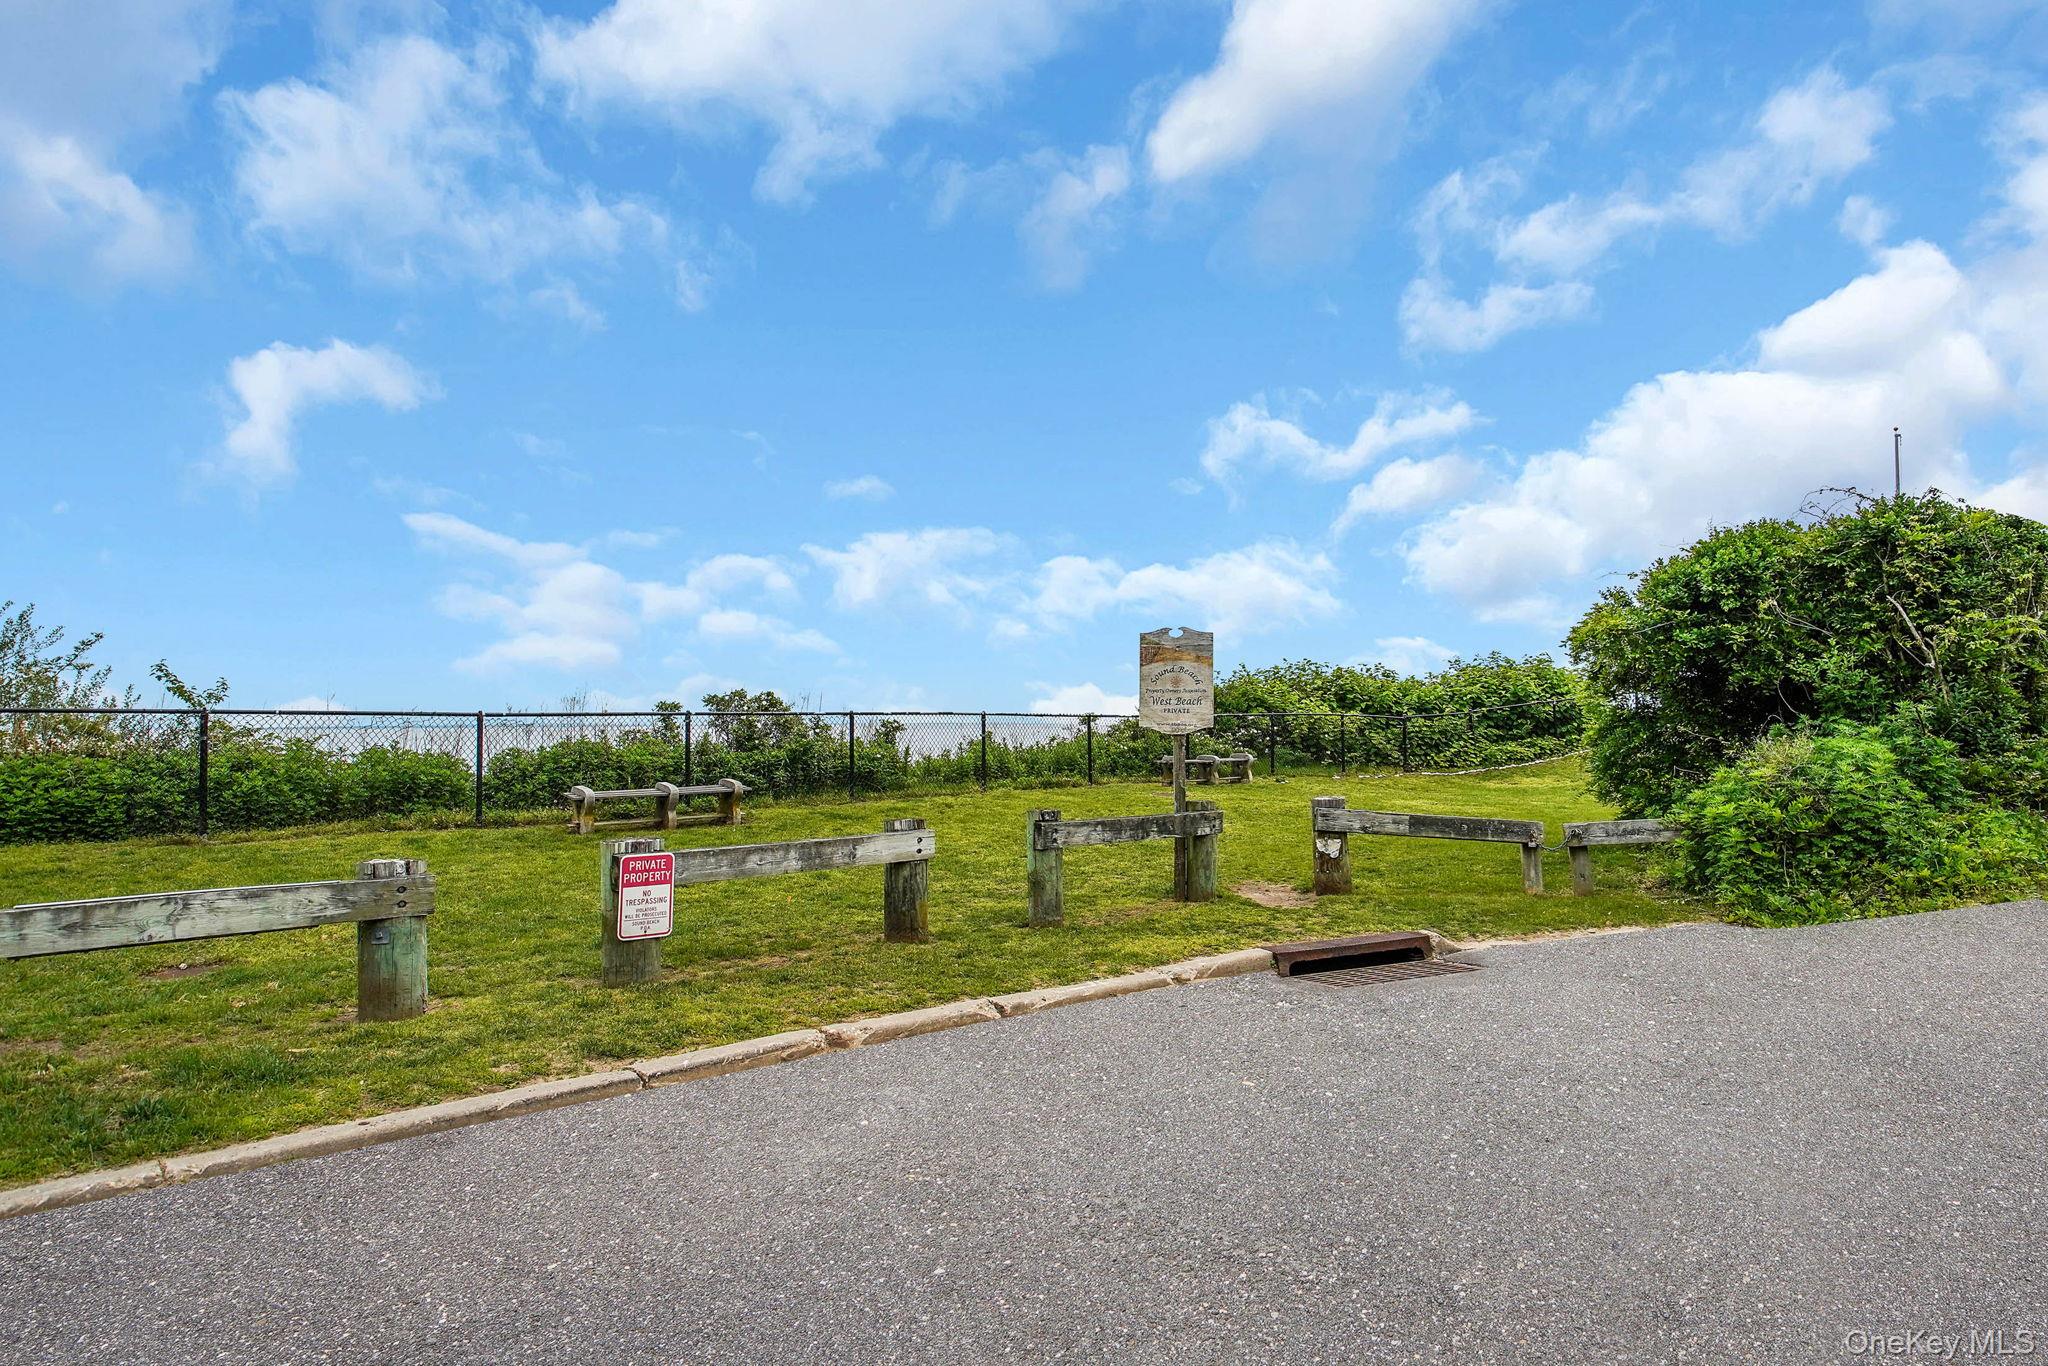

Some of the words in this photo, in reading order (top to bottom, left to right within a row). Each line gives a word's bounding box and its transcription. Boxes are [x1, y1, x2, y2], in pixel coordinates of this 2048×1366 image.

[1151, 664, 1177, 686] Sound
[1177, 665, 1204, 686] Beach
[1149, 695, 1173, 706] West
[1174, 695, 1203, 706] Beach
[629, 859, 667, 871] PRIVATE
[623, 870, 671, 884] PROPERTY
[625, 896, 668, 907] TRESPASSING
